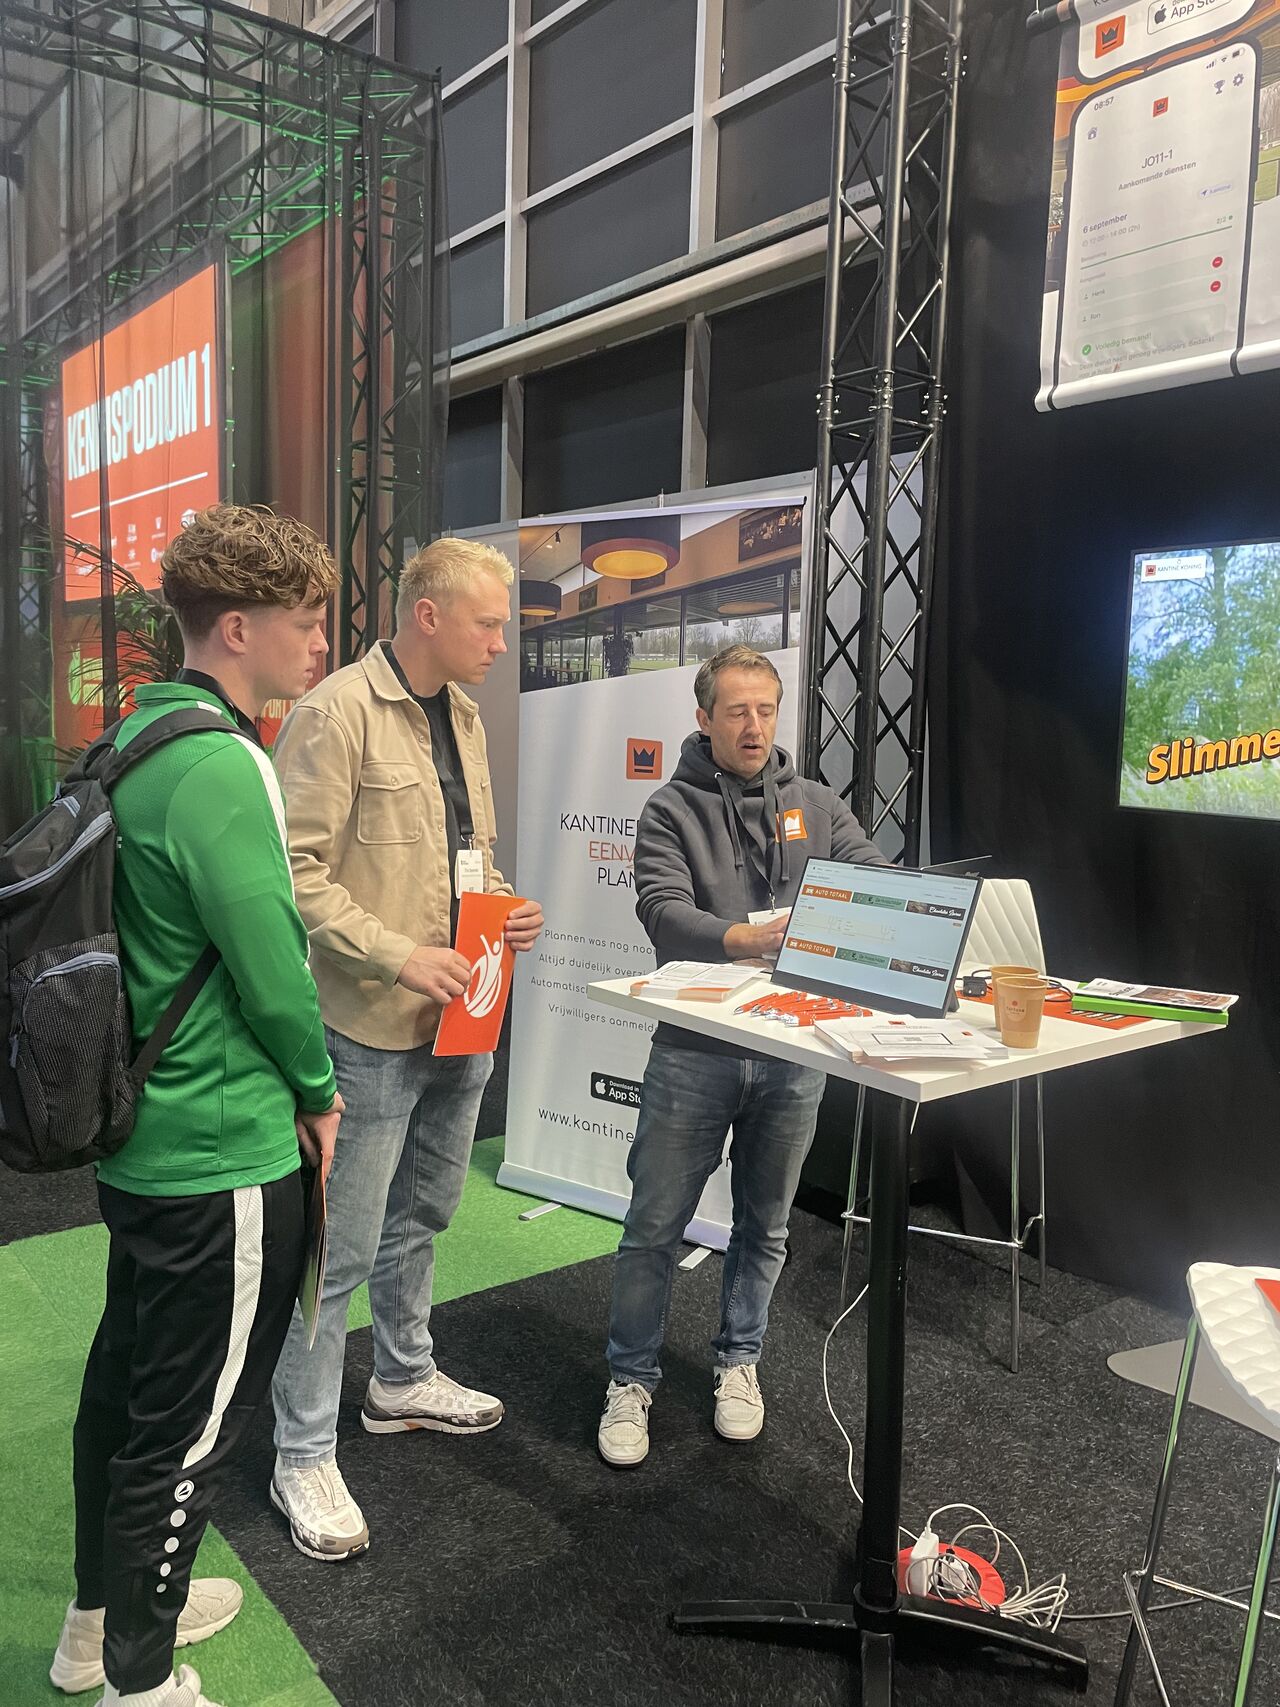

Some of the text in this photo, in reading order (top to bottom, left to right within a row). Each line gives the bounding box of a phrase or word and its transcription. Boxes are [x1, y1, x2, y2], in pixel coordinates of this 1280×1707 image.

[1171, 3, 1194, 19] App
[1094, 96, 1114, 111] 08:57
[1141, 149, 1173, 169] JO11-1
[1164, 161, 1196, 177] diensten
[1083, 214, 1128, 234] 6 september
[201, 342, 210, 427] 1
[1146, 729, 1280, 784] Slimme
[560, 813, 639, 837] KANTINE
[815, 888, 848, 900] AUTO TOTAAL
[545, 929, 586, 943] Plannen
[588, 938, 606, 947] was
[610, 940, 629, 953] nog
[799, 943, 832, 955] AUTO TOTAAL
[539, 953, 565, 966] Altijd
[569, 958, 611, 975] duidelijk
[548, 1003, 606, 1023] Vrijwilligers
[608, 1087, 628, 1102] App
[609, 1080, 634, 1091] Download
